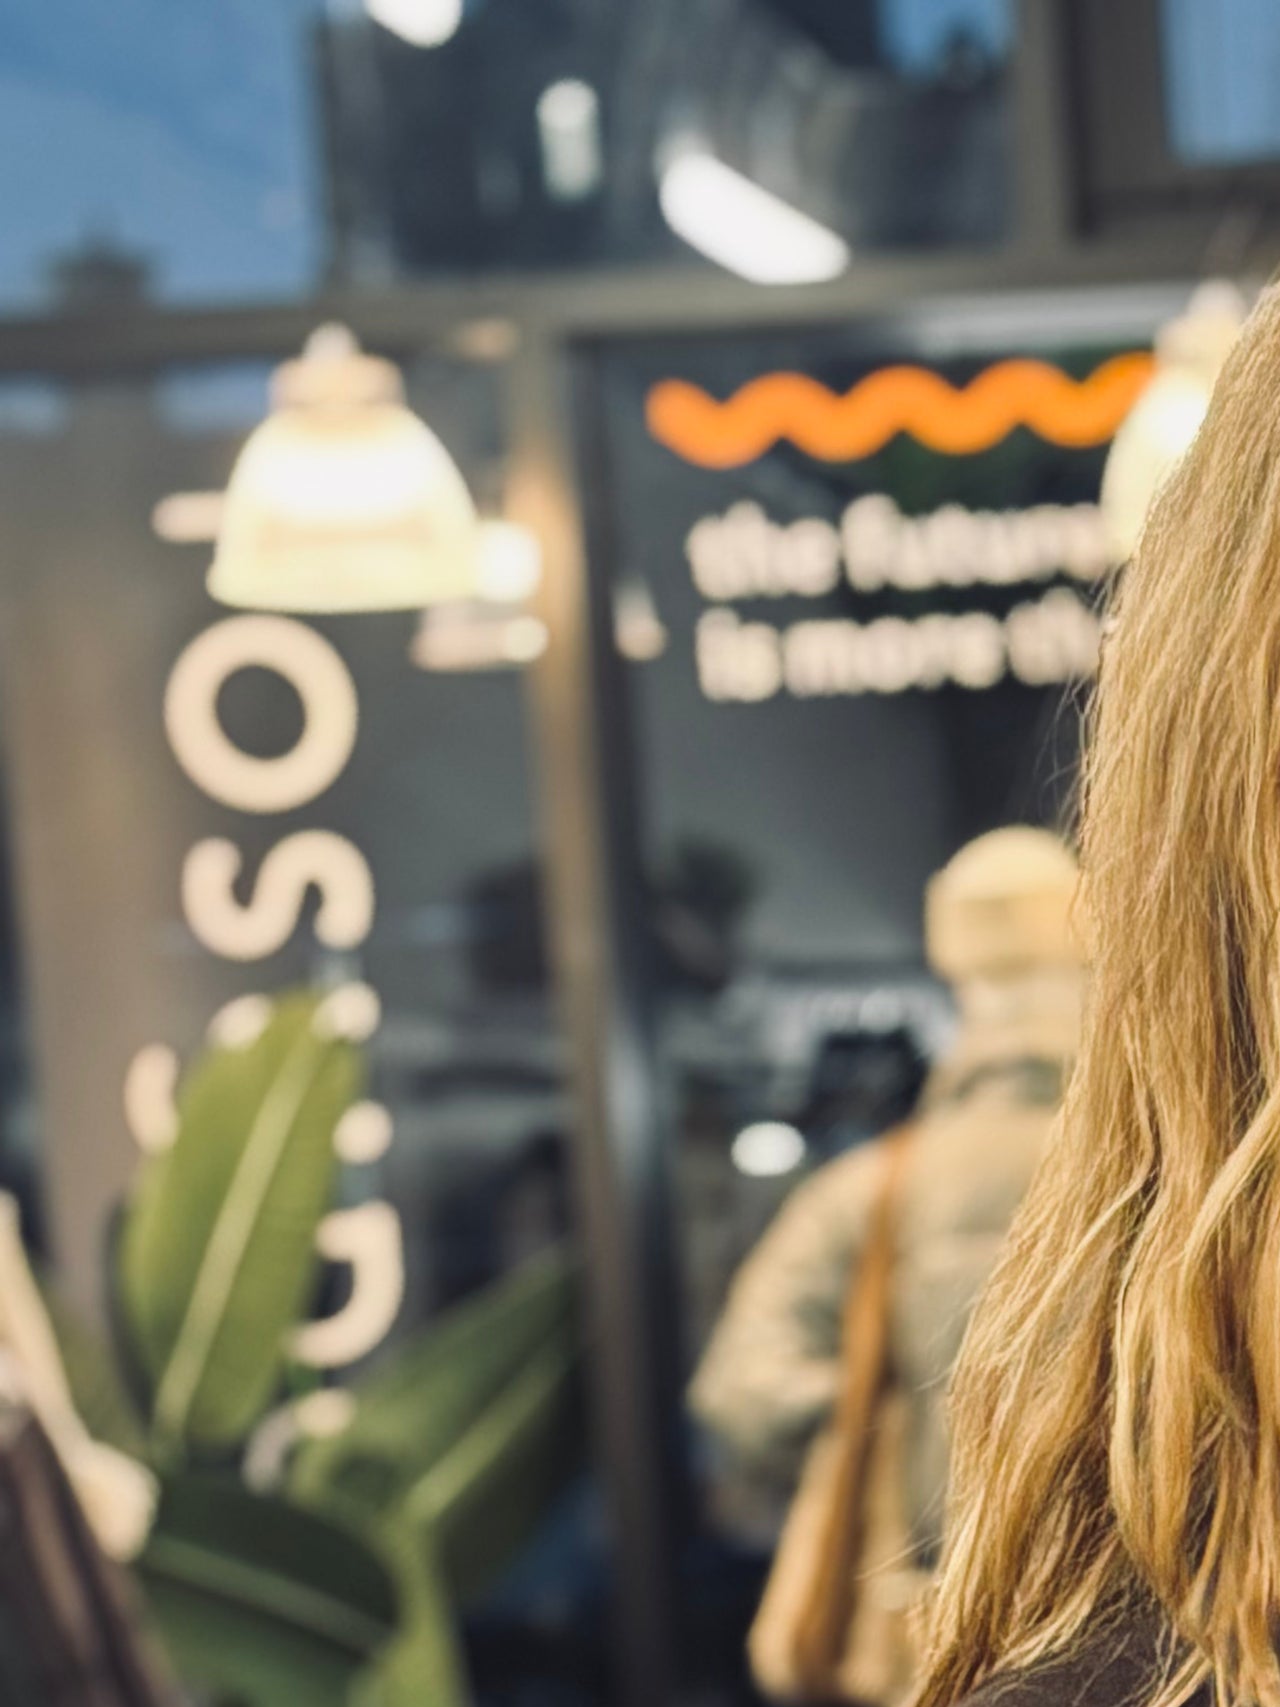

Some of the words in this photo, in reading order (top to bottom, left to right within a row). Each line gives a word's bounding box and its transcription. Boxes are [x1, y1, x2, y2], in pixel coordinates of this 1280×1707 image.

[688, 502, 839, 598] the
[695, 608, 780, 701] is
[784, 613, 1002, 695] more
